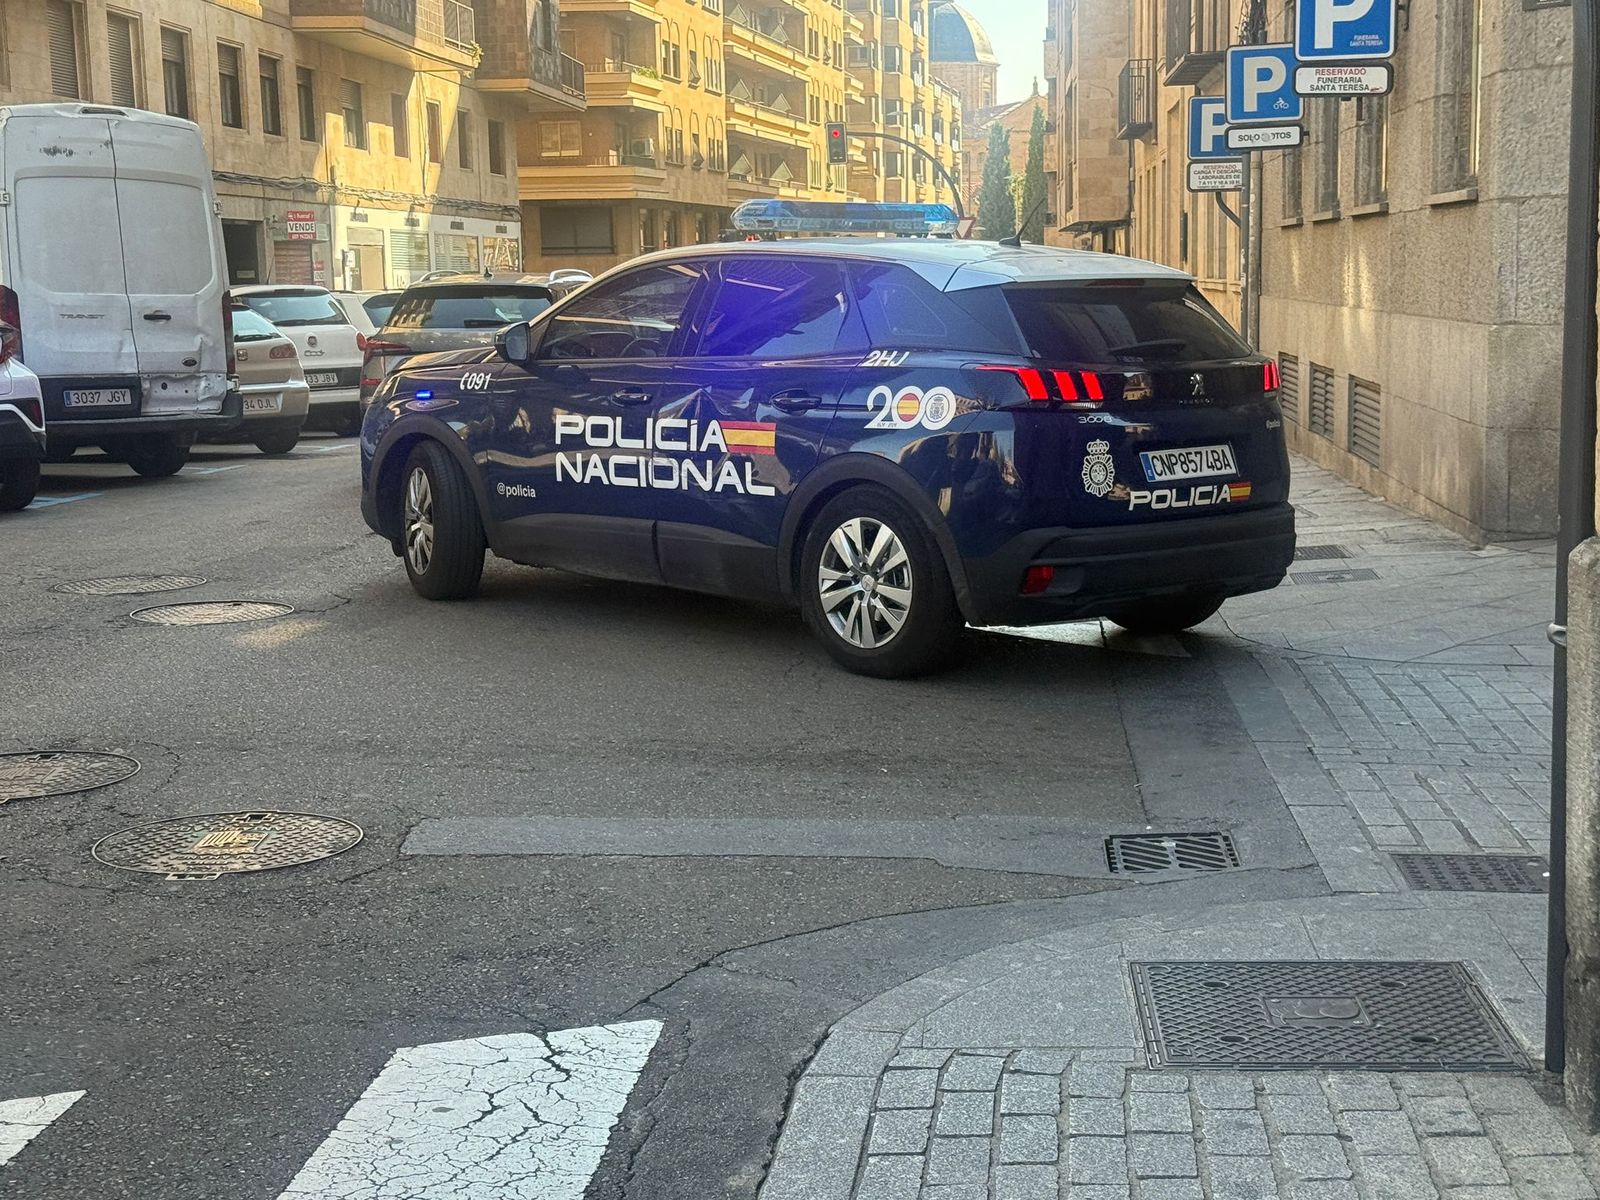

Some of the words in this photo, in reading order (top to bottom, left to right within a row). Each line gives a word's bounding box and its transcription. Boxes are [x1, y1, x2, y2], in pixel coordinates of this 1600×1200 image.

[1314, 0, 1373, 49] P
[1315, 68, 1366, 76] RESERVADO
[1243, 56, 1286, 112] P
[1261, 131, 1292, 141] OTOS
[288, 223, 315, 232] VENDE
[860, 350, 910, 367] 2HJ
[466, 372, 492, 390] 091
[73, 391, 101, 405] 3037
[107, 390, 127, 403] JGY
[243, 400, 256, 410] 34
[863, 385, 957, 430] 200
[1151, 449, 1233, 476] CNP8574BA
[555, 451, 776, 497] NACIONAL
[496, 482, 537, 498] @policia
